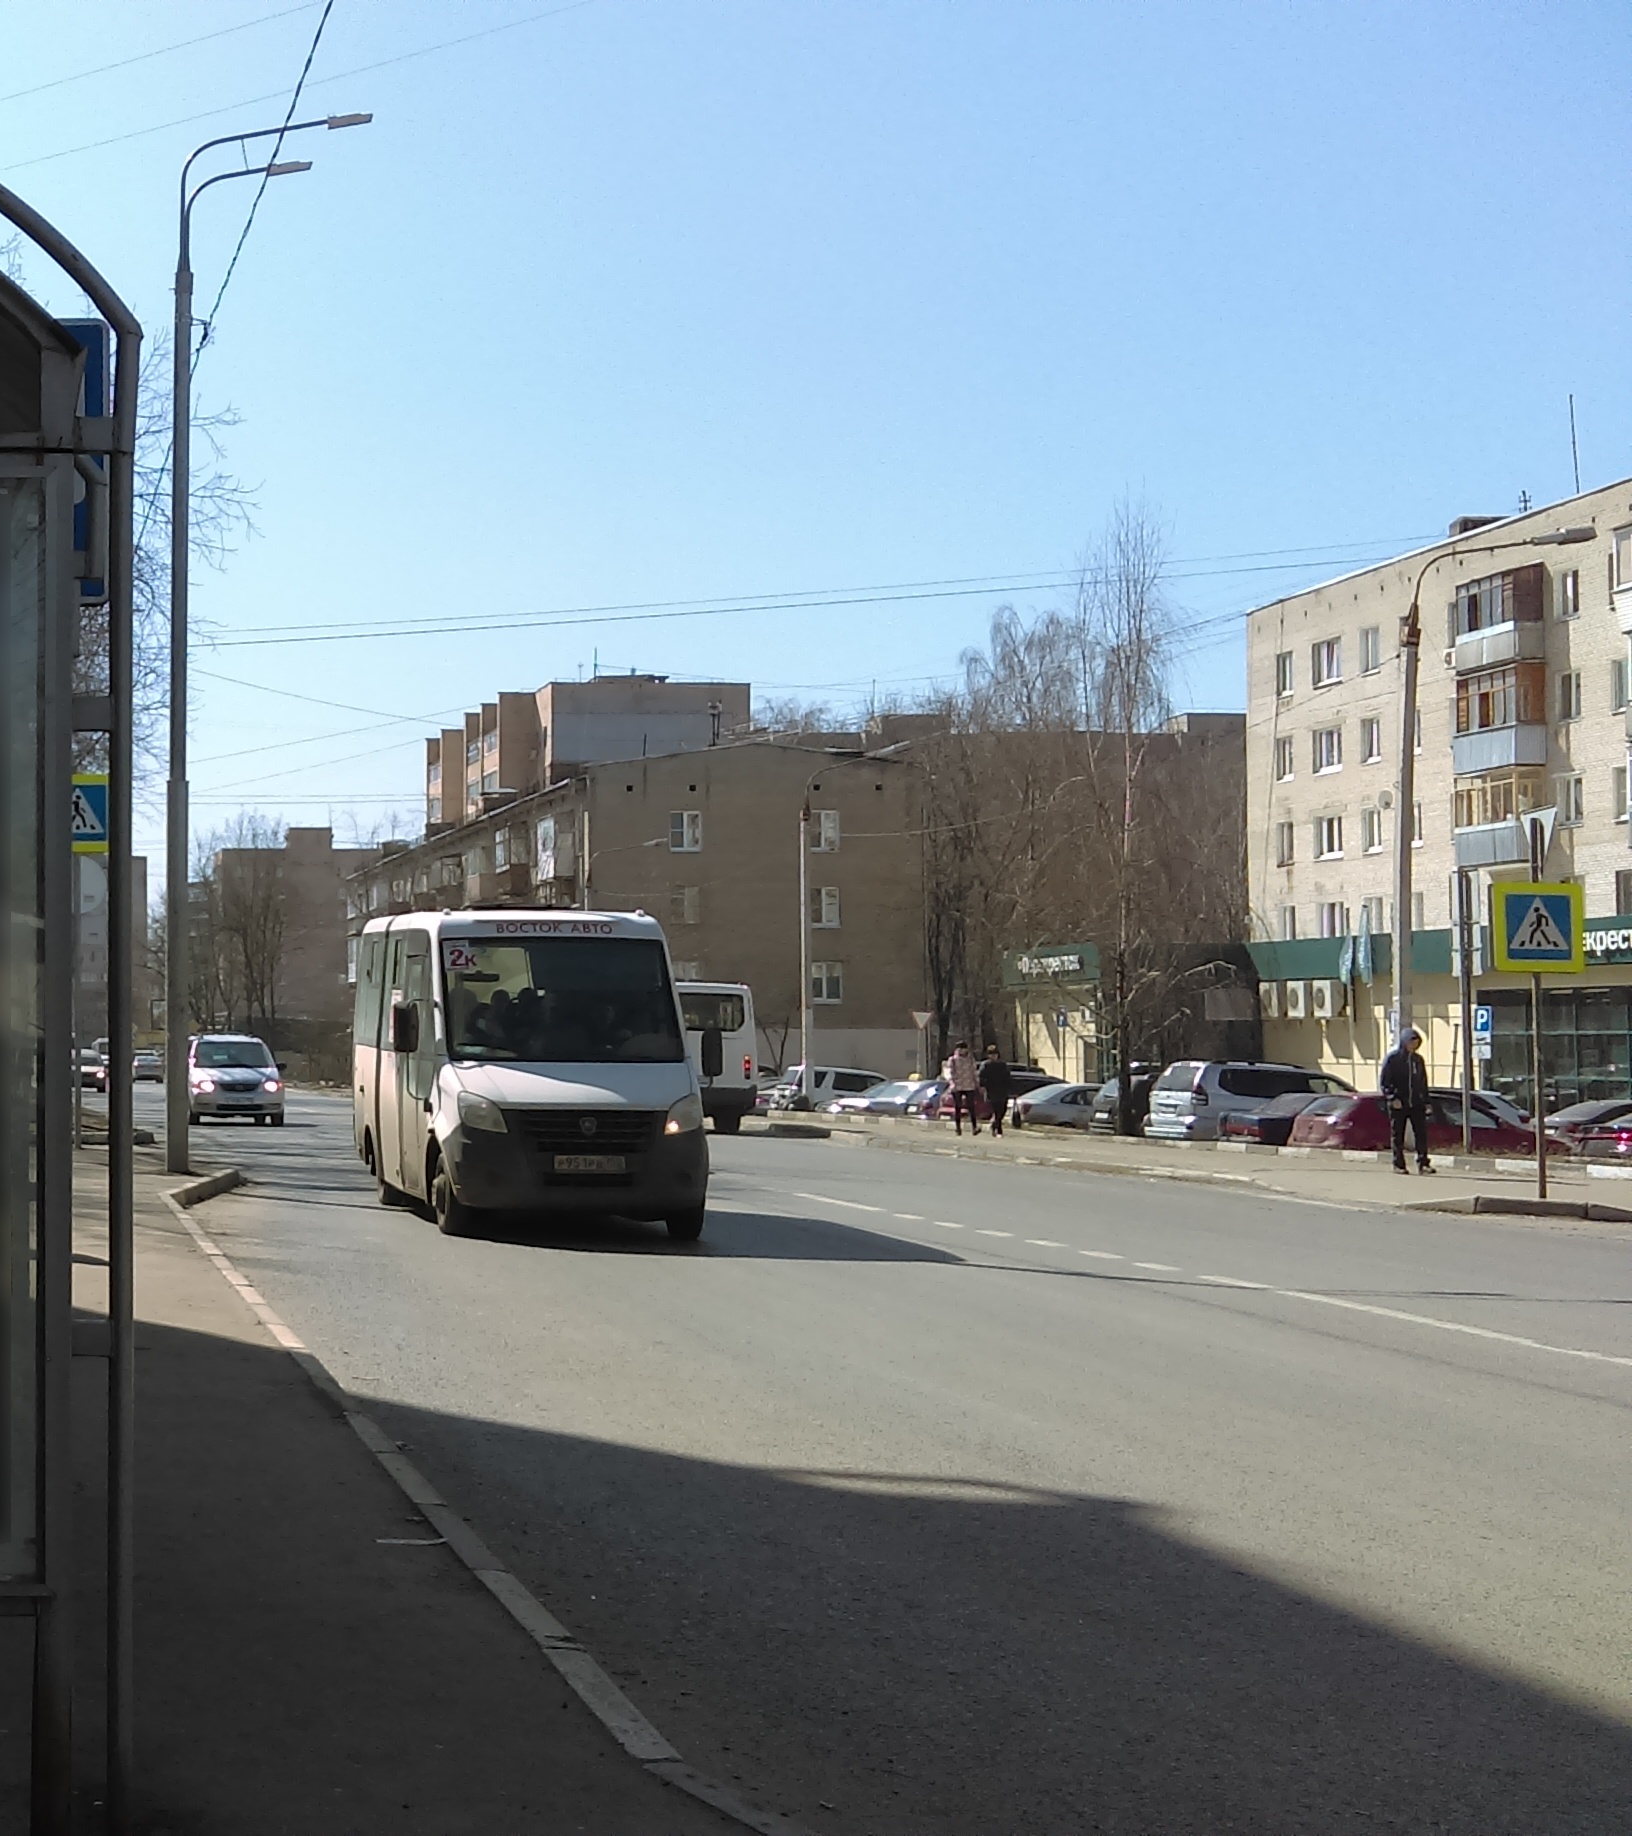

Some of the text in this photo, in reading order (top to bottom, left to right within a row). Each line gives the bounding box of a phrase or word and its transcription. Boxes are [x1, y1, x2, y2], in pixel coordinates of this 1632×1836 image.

[496, 922, 613, 935] ВОСТОК АВТО
[1476, 1009, 1488, 1030] P
